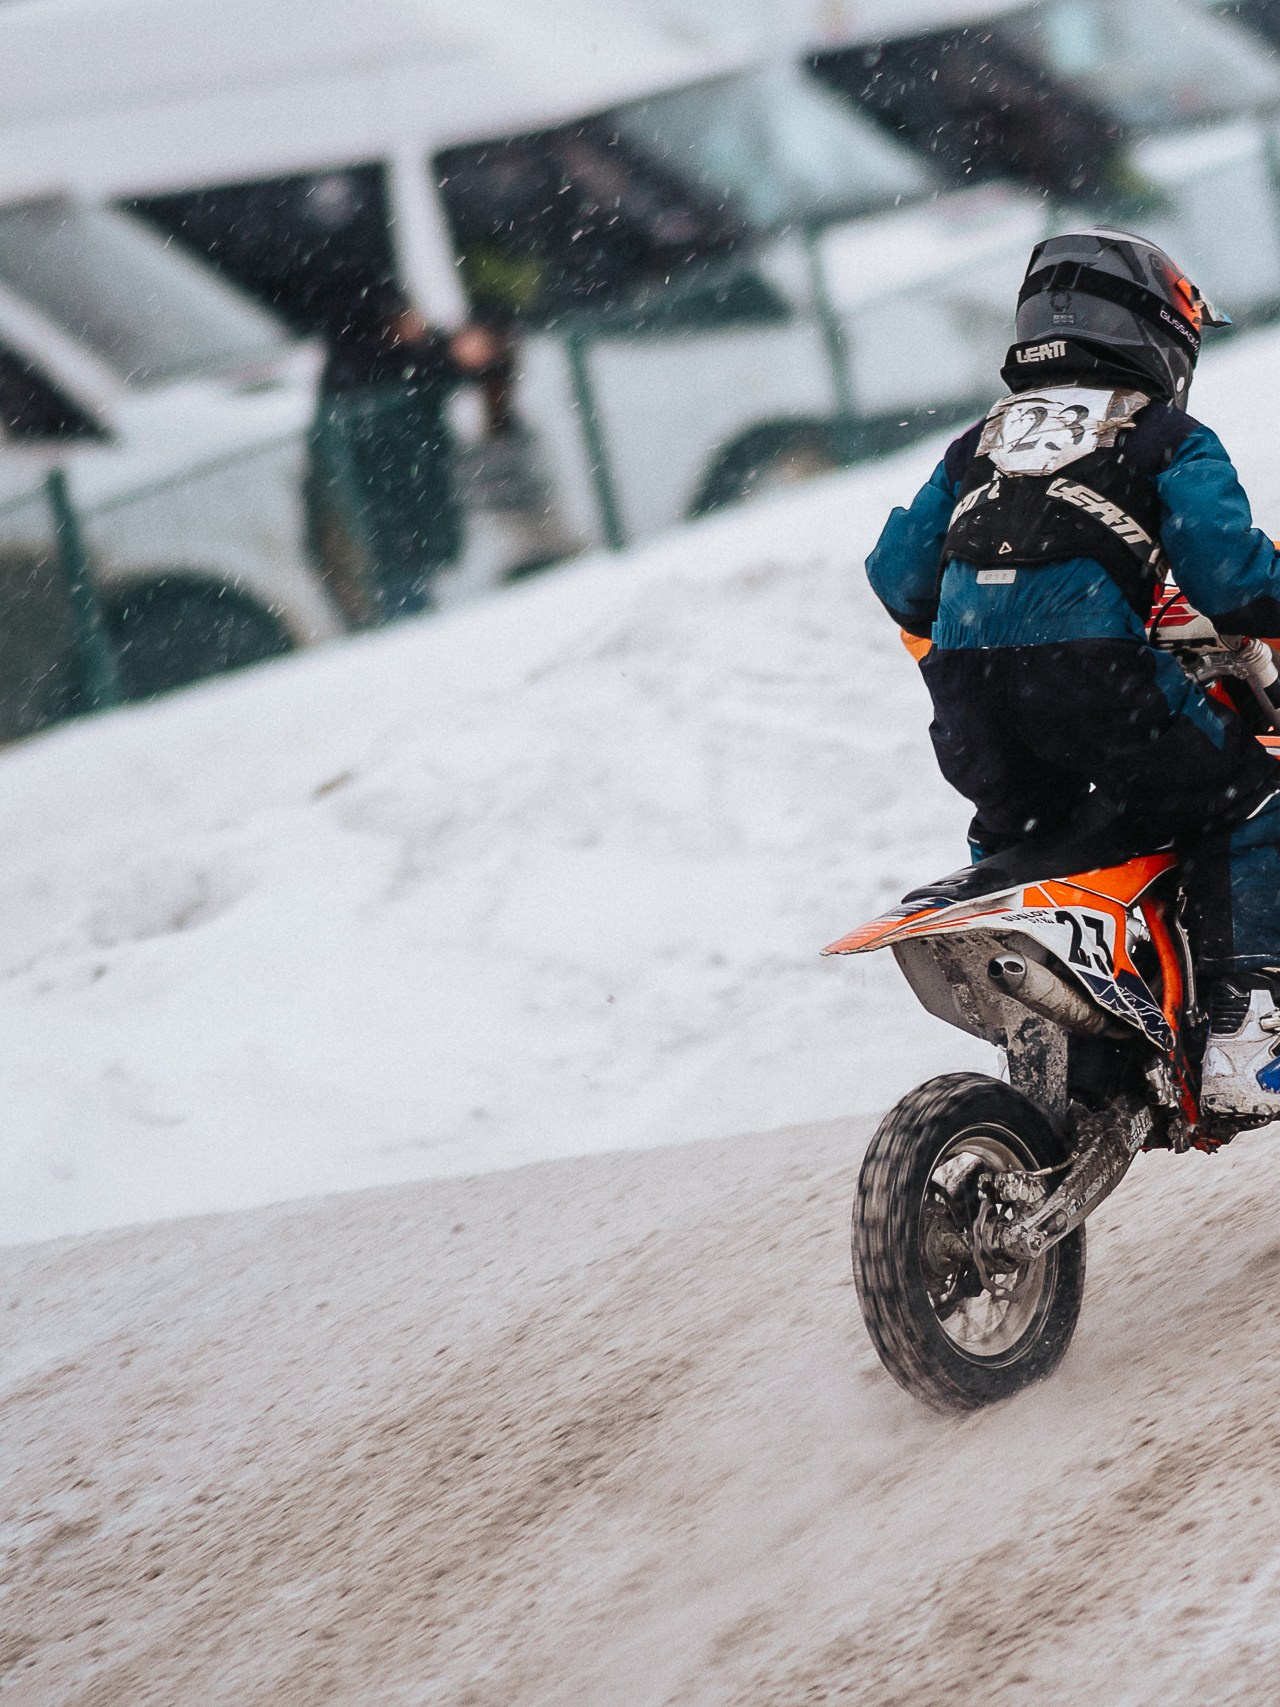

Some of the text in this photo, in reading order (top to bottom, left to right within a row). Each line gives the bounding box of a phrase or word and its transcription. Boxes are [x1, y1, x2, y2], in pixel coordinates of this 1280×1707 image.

[1016, 340, 1068, 363] LEATT
[1008, 404, 1090, 452] 23
[1046, 478, 1152, 544] LEATT
